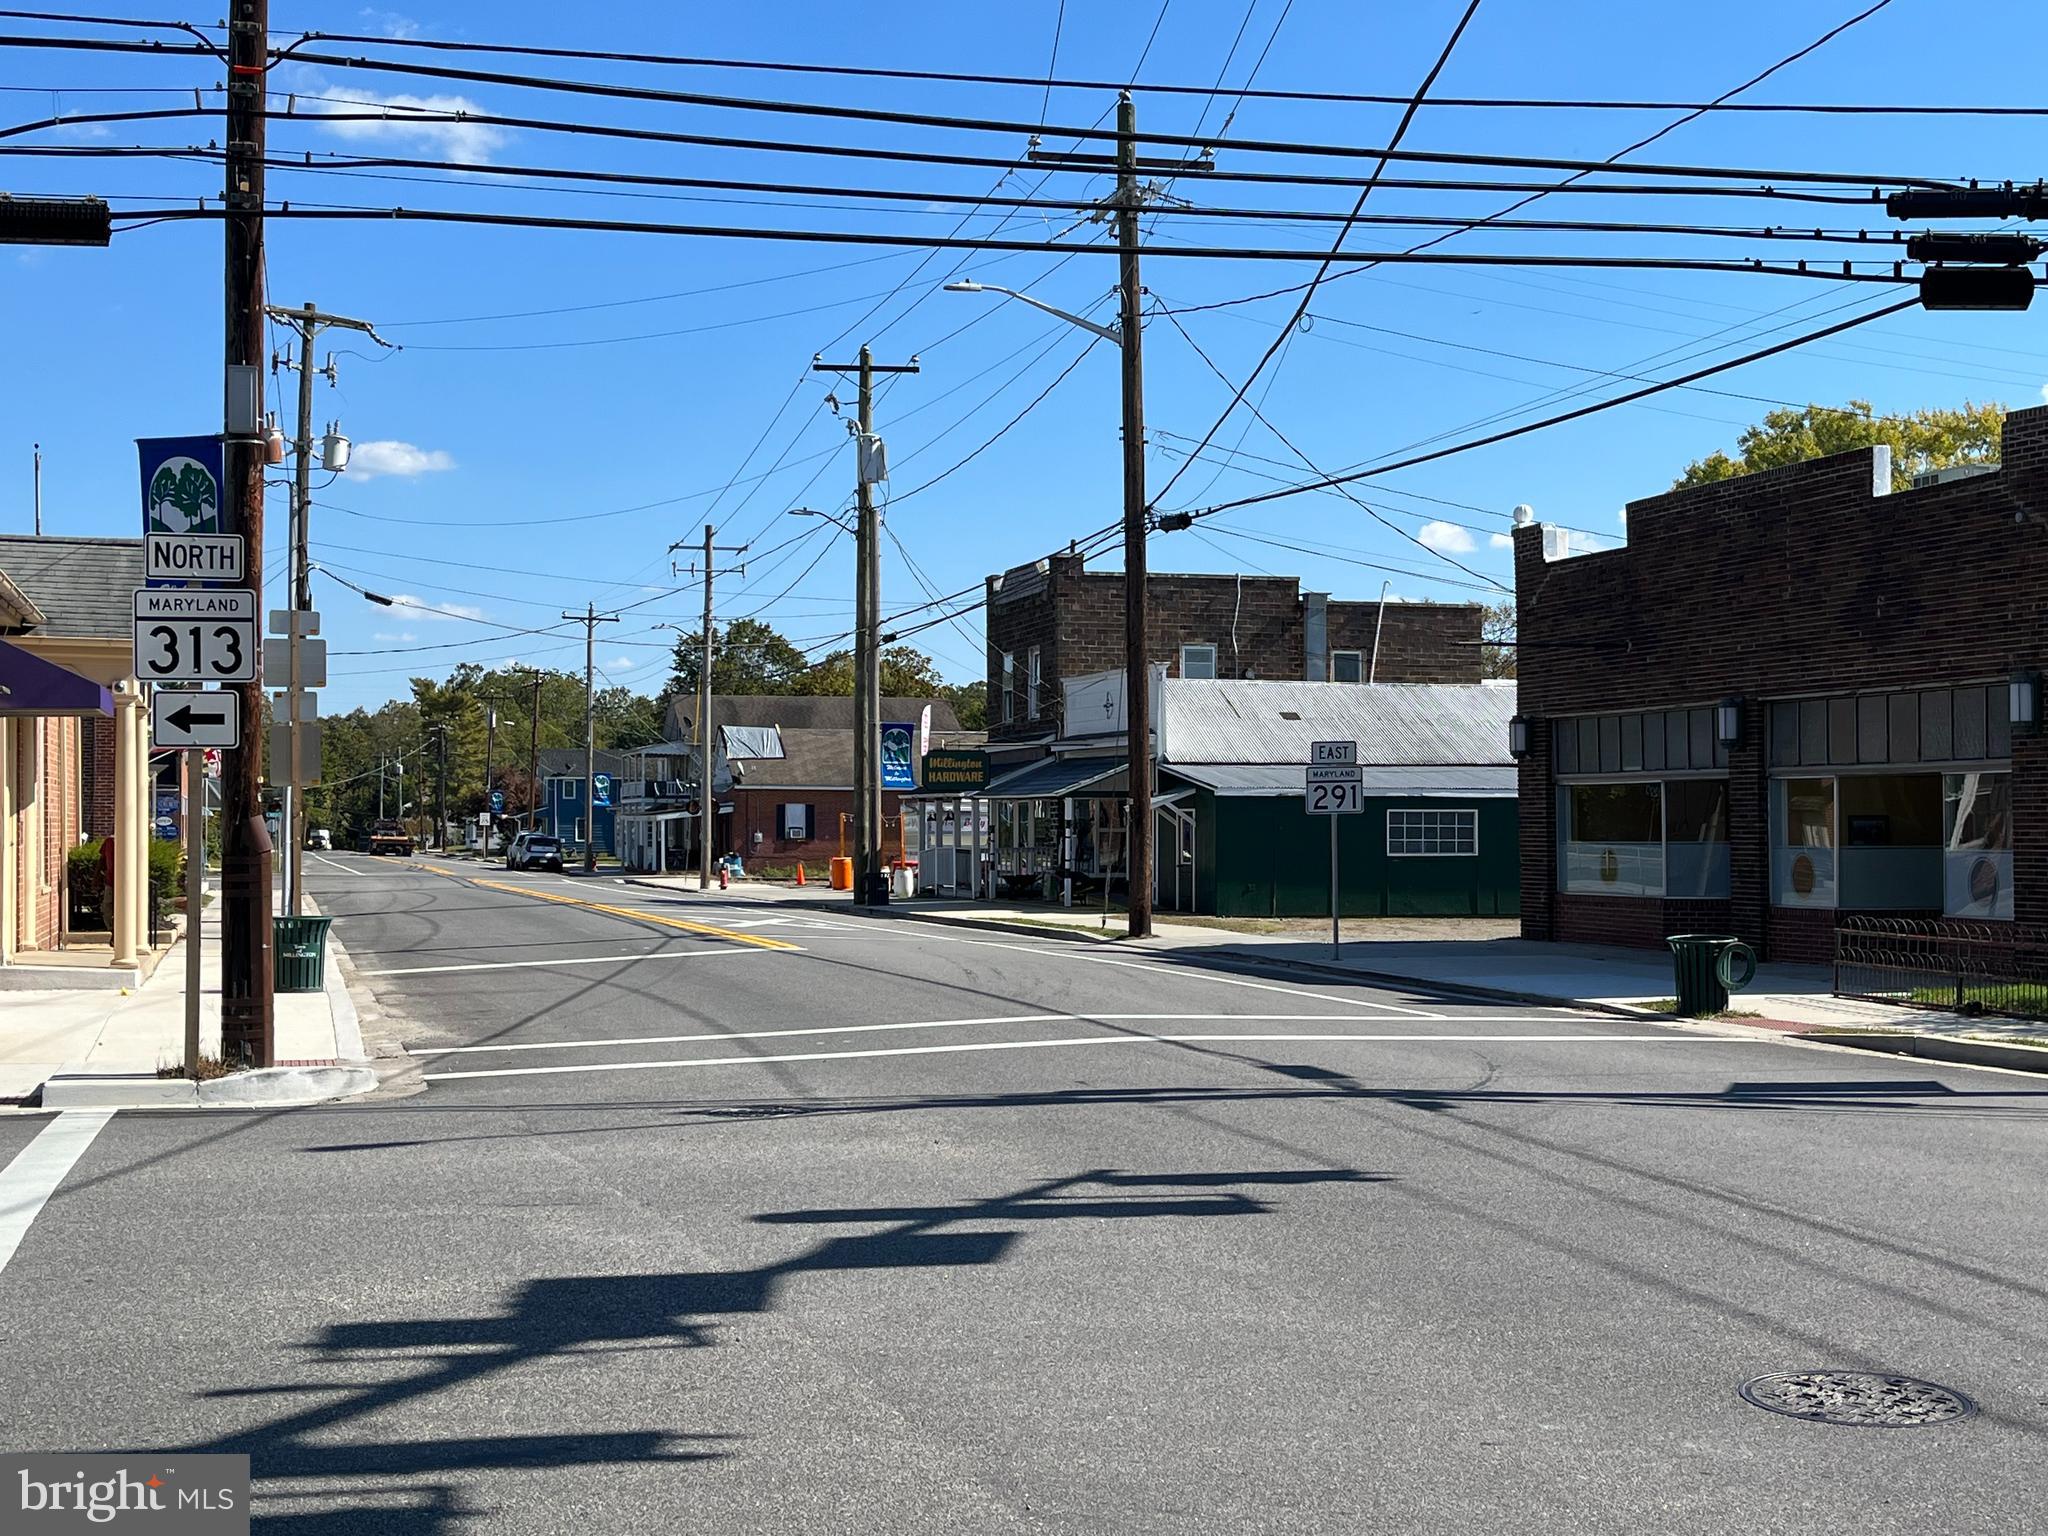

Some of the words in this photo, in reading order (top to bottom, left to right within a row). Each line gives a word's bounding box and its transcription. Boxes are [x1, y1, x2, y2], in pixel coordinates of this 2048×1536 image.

[154, 541, 235, 570] NORTH
[149, 598, 239, 612] MARYLAND
[148, 625, 242, 675] 313
[1319, 745, 1349, 759] EAST
[928, 772, 983, 782] HARDWARE
[1313, 770, 1355, 778] MARYLAND
[1313, 784, 1356, 810] 291
